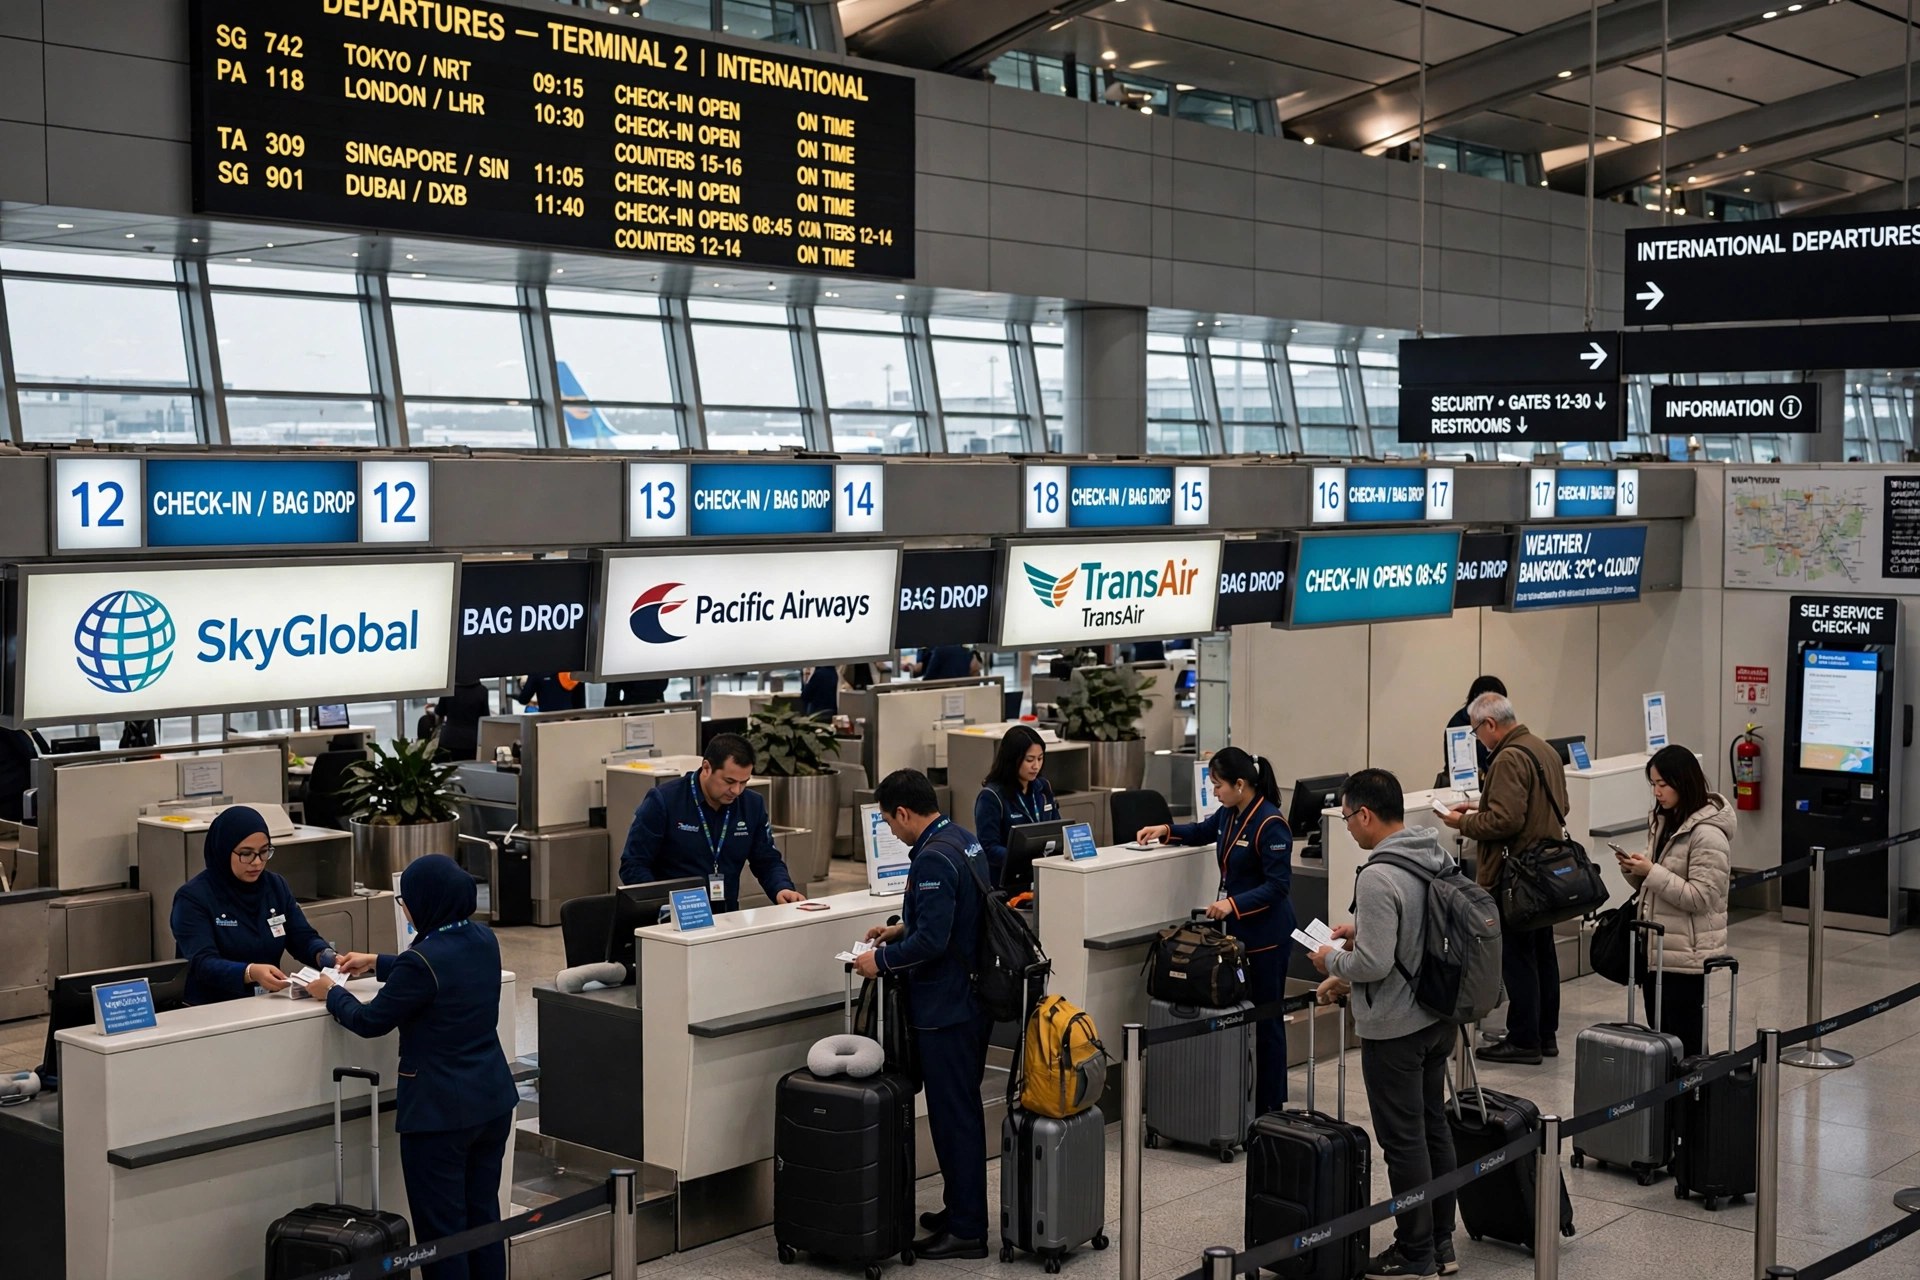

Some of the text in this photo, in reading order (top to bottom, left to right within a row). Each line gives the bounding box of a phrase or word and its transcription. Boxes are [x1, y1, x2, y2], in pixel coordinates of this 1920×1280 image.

[547, 22, 666, 68] TERMINAL
[674, 45, 687, 71] 2
[717, 52, 869, 101] INTERNATIONAL
[216, 24, 855, 138] SG 742 TOKYO / NRT 09:15 CHECK-IN OPEN ON TIME
[217, 59, 855, 165] PA 118 LONDON / LHR 10:30 CHECK-IN OPEN ON TIME
[217, 127, 855, 217] TA 309 SINGAPORE / SIN 11:05 CHECK-IN OPEN ON TIME
[615, 143, 855, 191] COUNTERS 15-16 ON TIME
[218, 161, 249, 185] SG
[265, 166, 303, 190] 901
[346, 174, 406, 200] DUBAI
[412, 180, 422, 202] /
[428, 182, 467, 206] DXB
[535, 195, 584, 217] 11:40
[615, 201, 693, 229] CHECK-IN
[698, 210, 749, 234] OPENS
[753, 216, 792, 237] 08:45
[860, 227, 892, 246] 12-14
[615, 228, 855, 267] COUNTERS 12-14 ON TIME
[1637, 224, 1920, 262] INTERNATIONAL DEPARTURES
[1431, 395, 1493, 412] SECURITY
[1508, 394, 1551, 411] GATES
[1555, 393, 1591, 410] 12-30
[1666, 400, 1774, 418] INFORMATION
[1431, 417, 1512, 434] RESTROOMS
[71, 482, 125, 527] 12
[153, 491, 356, 517] CHECK-IN / BAG DROP
[373, 482, 417, 523] 12
[640, 481, 676, 520] 13
[694, 489, 831, 511] CHECK-IN / BAG DROP
[843, 481, 874, 516] 14
[1033, 481, 1059, 513] 18
[1071, 487, 1120, 506] CHECK-IN
[1128, 487, 1148, 506] BAG
[1149, 487, 1171, 505] DROP
[1180, 481, 1202, 511] 15
[1319, 481, 1339, 509] 16
[1349, 487, 1385, 503] CHECK-IN
[1392, 487, 1407, 503] BAG
[1408, 487, 1425, 501] DROP
[1431, 481, 1448, 507] 17
[1535, 481, 1551, 506] 17
[1621, 481, 1634, 504] 18
[1525, 534, 1583, 556] WEATHER
[1081, 558, 1199, 600] TransAir
[1220, 571, 1285, 594] BAG DROP
[1305, 562, 1448, 593] CHECK-IN OPENS 08:45
[1456, 560, 1508, 580] BAG DROP
[1519, 560, 1573, 583] BANGKOK:
[1604, 556, 1641, 577] CLOUDY
[695, 590, 870, 625] Pacific Airways
[900, 585, 988, 611] BAG DROP
[1800, 604, 1884, 620] SELF SERVICE
[463, 603, 584, 636] BAG DROP
[1082, 605, 1145, 628] TransAir
[1812, 620, 1870, 634] CHECK-IN
[197, 609, 418, 671] SkyGlobal
